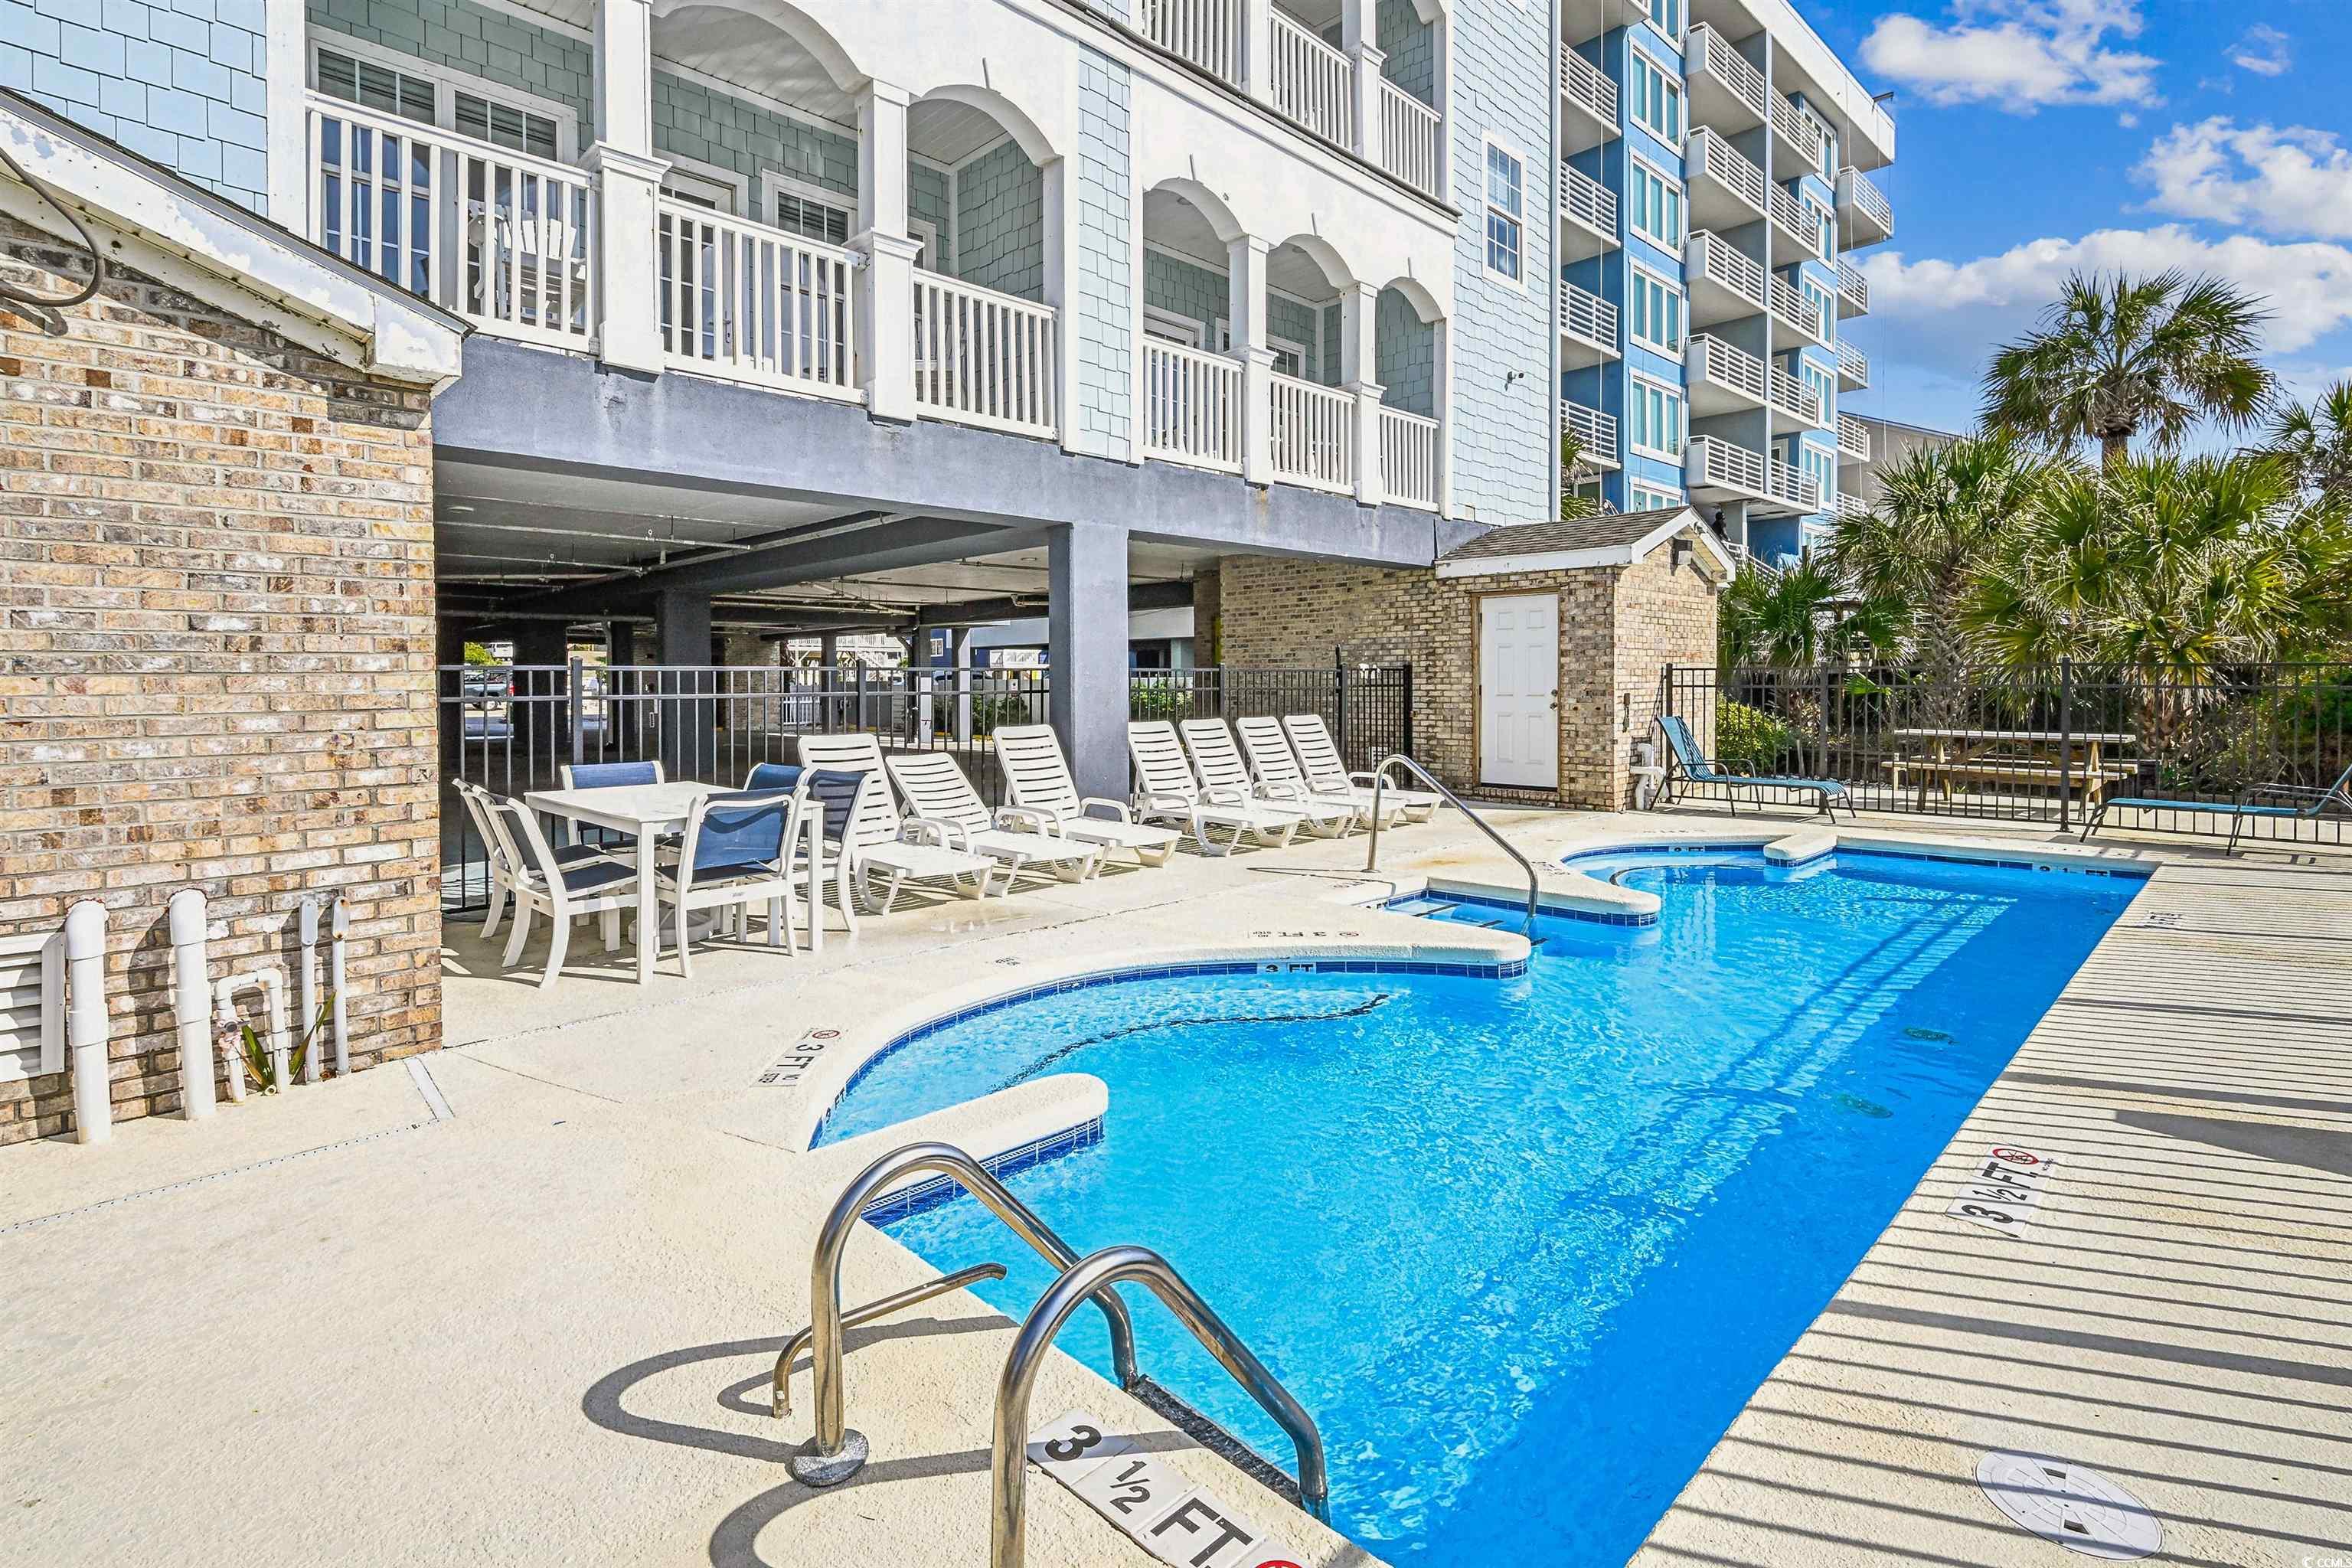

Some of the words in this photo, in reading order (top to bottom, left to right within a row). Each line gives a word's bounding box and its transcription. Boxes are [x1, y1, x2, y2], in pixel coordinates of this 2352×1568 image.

[1289, 964, 1314, 973] FT
[776, 1056, 815, 1069] FT
[1962, 1204, 2014, 1223] 3
[1045, 1425, 1102, 1462] 3
[1150, 1497, 1254, 1568] FT
